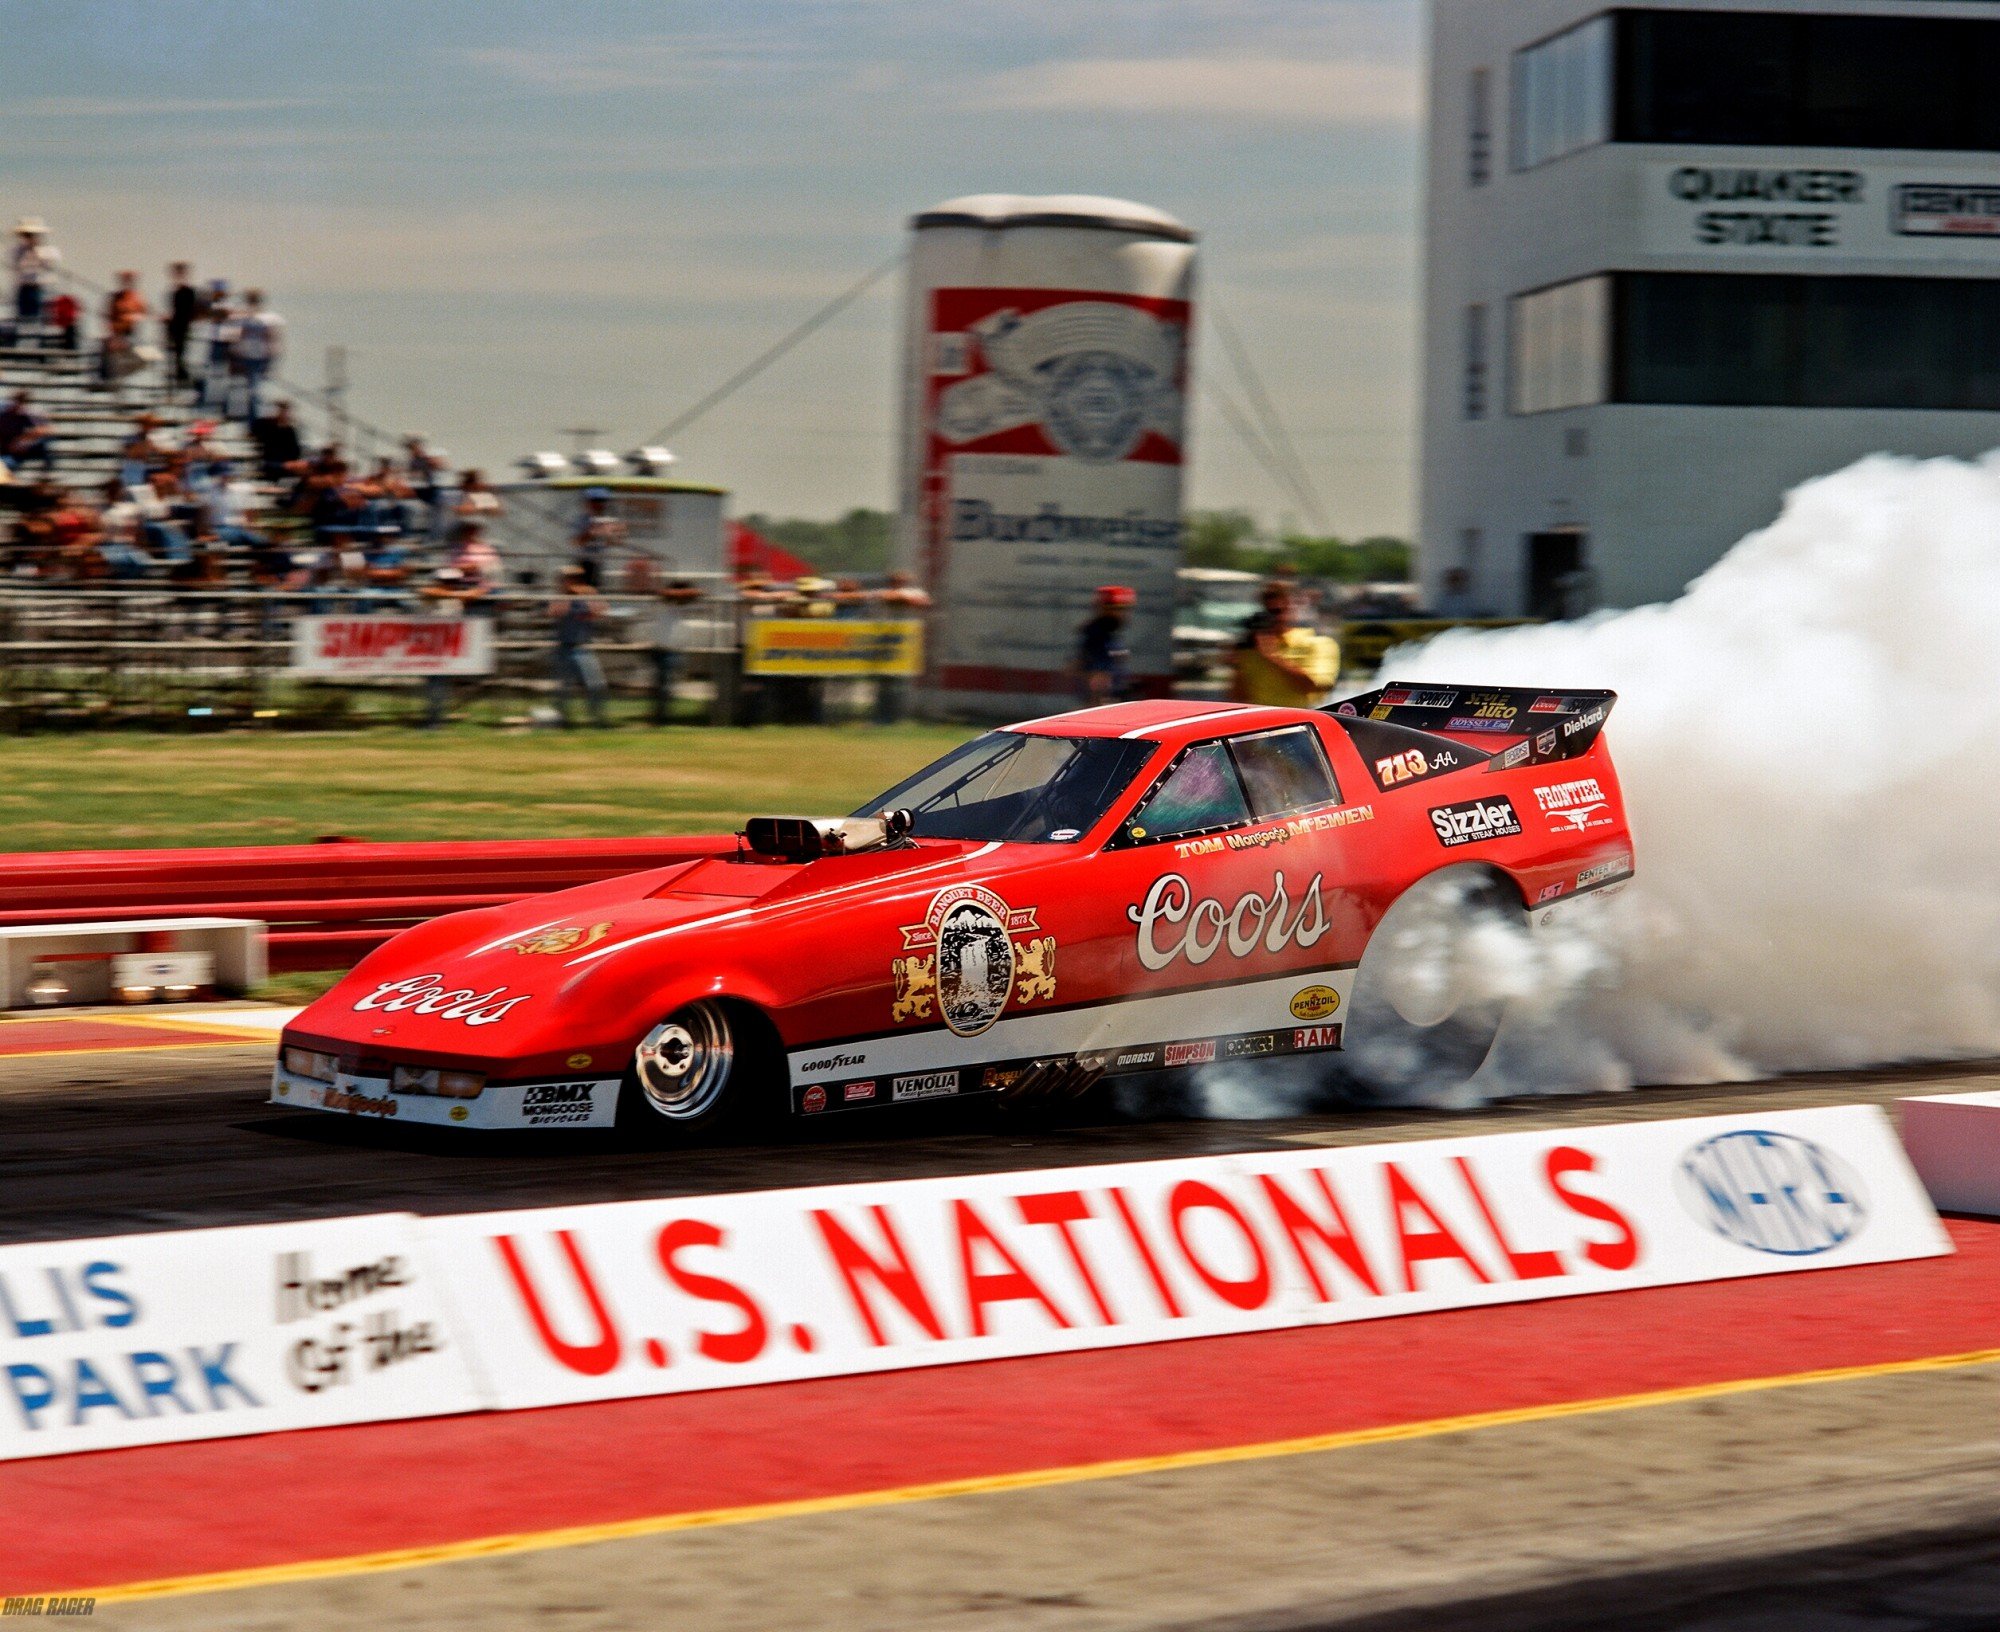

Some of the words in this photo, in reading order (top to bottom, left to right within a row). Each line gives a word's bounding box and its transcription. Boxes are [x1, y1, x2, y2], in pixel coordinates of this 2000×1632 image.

[1669, 167, 1864, 202] QUAKER
[1698, 211, 1838, 245] STATE
[320, 622, 467, 658] SIMPSON
[1415, 691, 1456, 706] SPORTS
[1450, 718, 1491, 728] ODYSSEY
[1473, 705, 1518, 719] AUTO
[1563, 707, 1604, 737] DieHard
[1375, 748, 1428, 787] 713
[1429, 751, 1458, 770] AA
[1533, 778, 1606, 811] FRONTIER
[1444, 833, 1470, 846] FAMILY
[1471, 830, 1495, 841] STEAK
[1495, 825, 1521, 837] HOUSES
[1174, 837, 1225, 859] TOM
[1579, 864, 1609, 882] CENTER
[929, 888, 973, 927] BANQUET
[975, 890, 1007, 920] BEER
[911, 931, 932, 942] Since
[1010, 914, 1028, 926] 1873
[1127, 870, 1332, 971] Coors
[352, 973, 532, 1027] Coors
[1293, 995, 1336, 1011] PENNZOIL
[1293, 1027, 1337, 1049] RAM
[801, 1053, 866, 1072] GOODYEAR
[1117, 1051, 1155, 1066] MOROSO
[1165, 1042, 1215, 1062] SIMPSON
[540, 1083, 597, 1103] BMX
[896, 1074, 956, 1093] VENOLIA
[522, 1102, 594, 1116] MONGOOSE
[529, 1113, 590, 1125] BICYCLES
[489, 1218, 818, 1377] U.S.
[806, 1145, 1641, 1349] NATIONALS
[275, 1251, 411, 1326] Home
[2, 1342, 265, 1431] PARK
